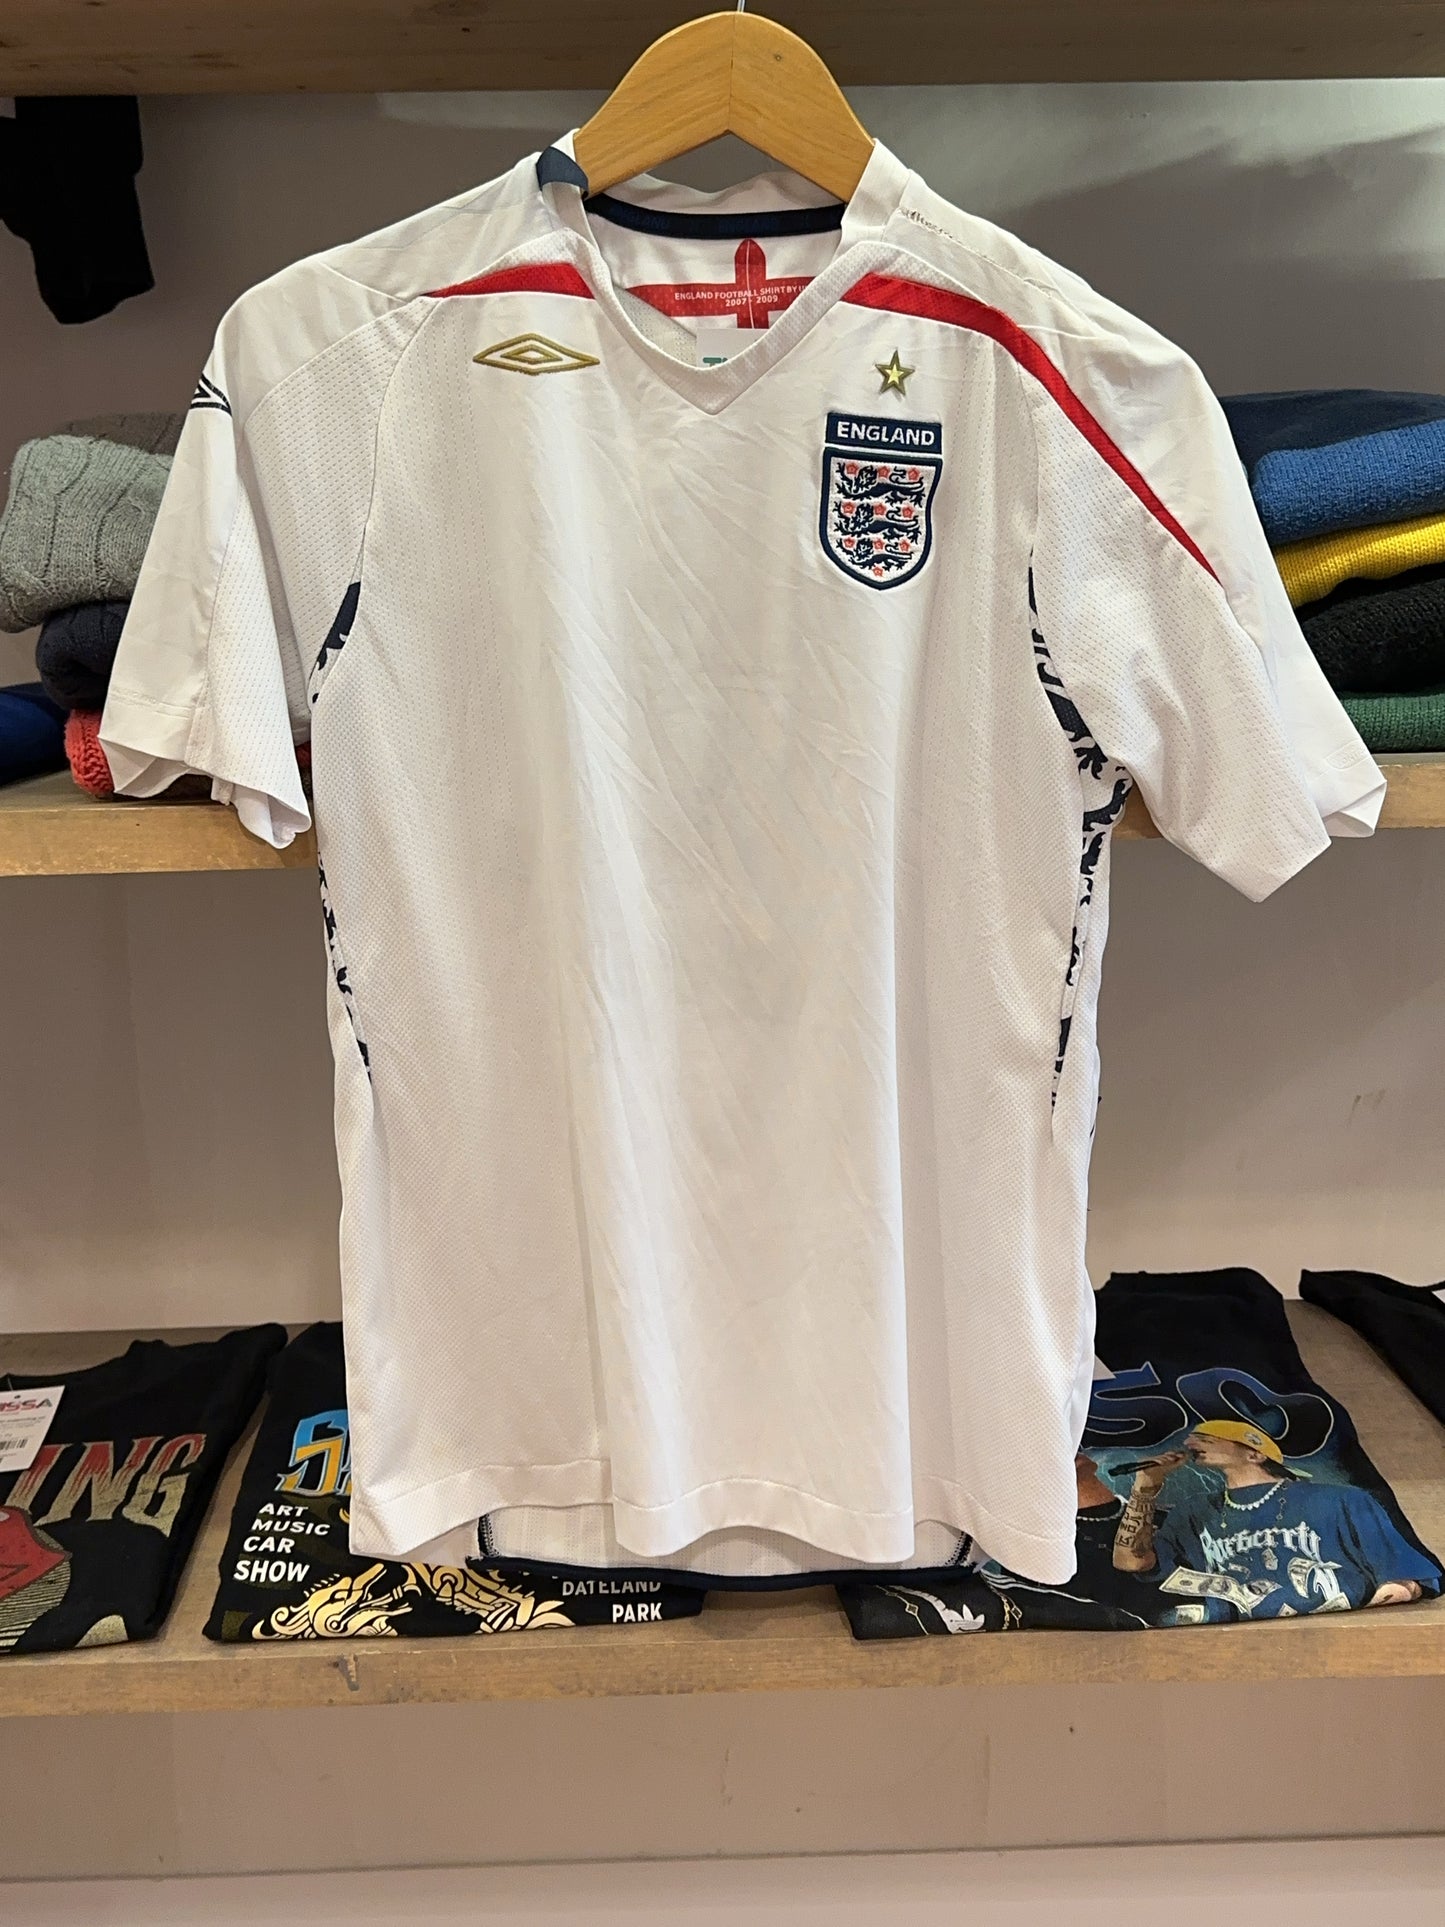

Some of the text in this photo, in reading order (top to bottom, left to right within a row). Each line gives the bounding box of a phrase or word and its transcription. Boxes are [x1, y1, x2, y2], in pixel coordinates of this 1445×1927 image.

[674, 291, 714, 301] ENGLAND
[714, 288, 758, 300] FOOTBALL
[759, 286, 785, 296] SHIRT
[786, 285, 798, 294] BY
[725, 298, 747, 307] 2007
[756, 295, 778, 304] 2009
[837, 420, 935, 446] ENGLAND
[258, 1502, 309, 1517] ART
[251, 1518, 331, 1536] MUSIC
[242, 1535, 296, 1554] CAR
[232, 1560, 311, 1583] SHOW
[561, 1580, 662, 1597] DATELAND
[611, 1602, 663, 1624] PARK
